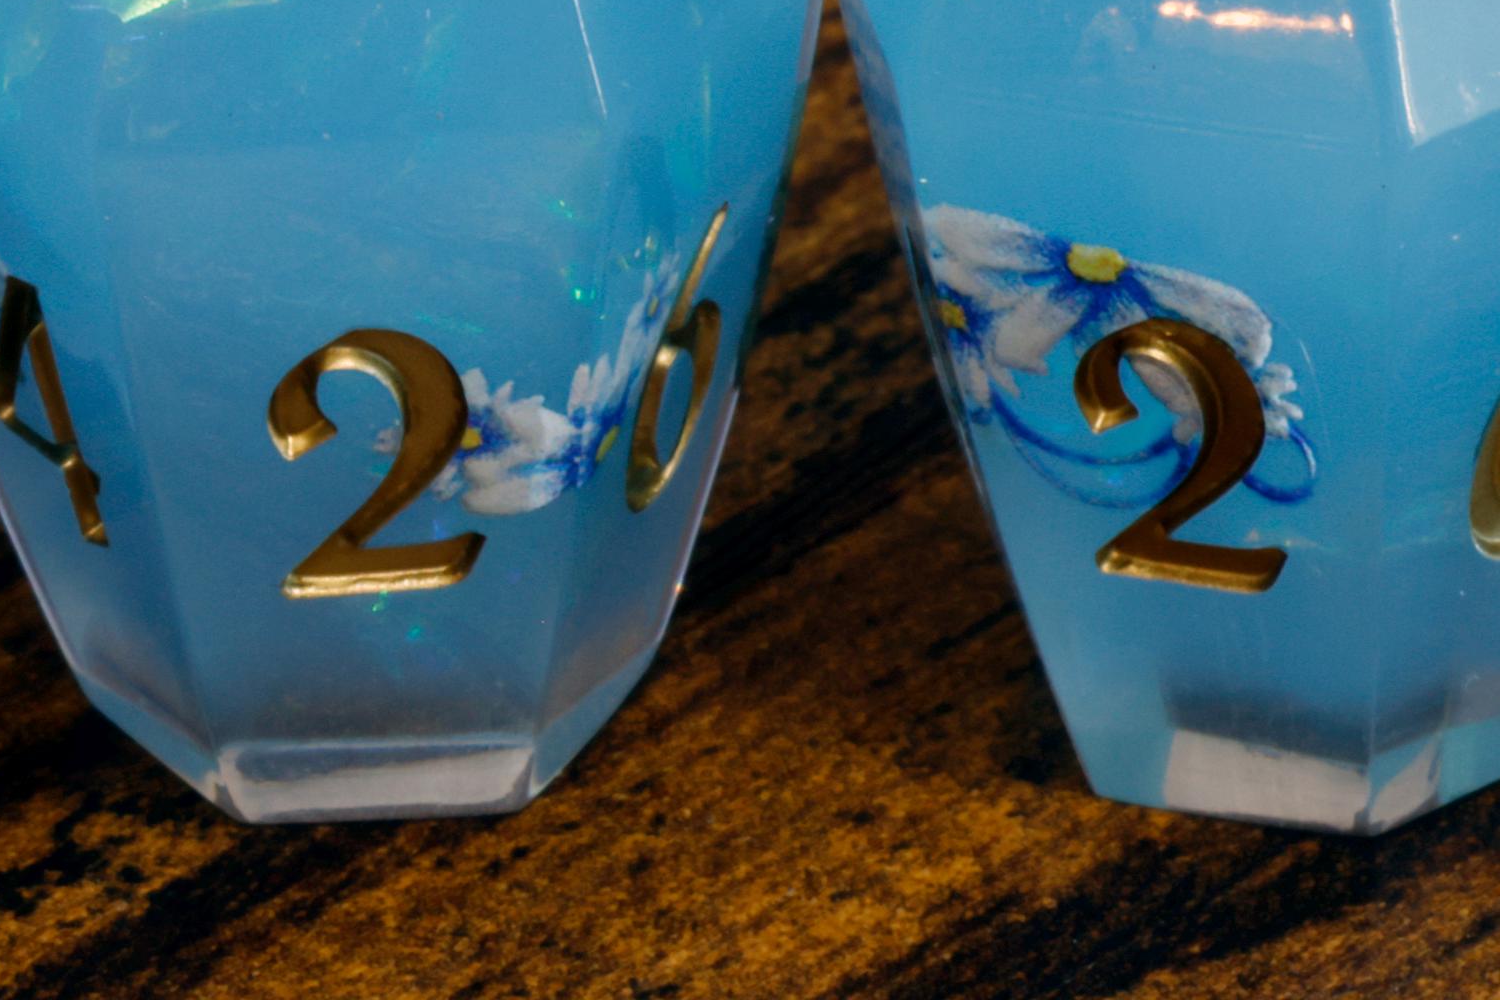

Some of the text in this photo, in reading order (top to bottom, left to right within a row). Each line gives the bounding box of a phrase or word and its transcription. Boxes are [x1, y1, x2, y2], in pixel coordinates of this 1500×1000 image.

[267, 328, 487, 600] 2
[626, 202, 727, 513] 6
[1073, 318, 1288, 593] 2
